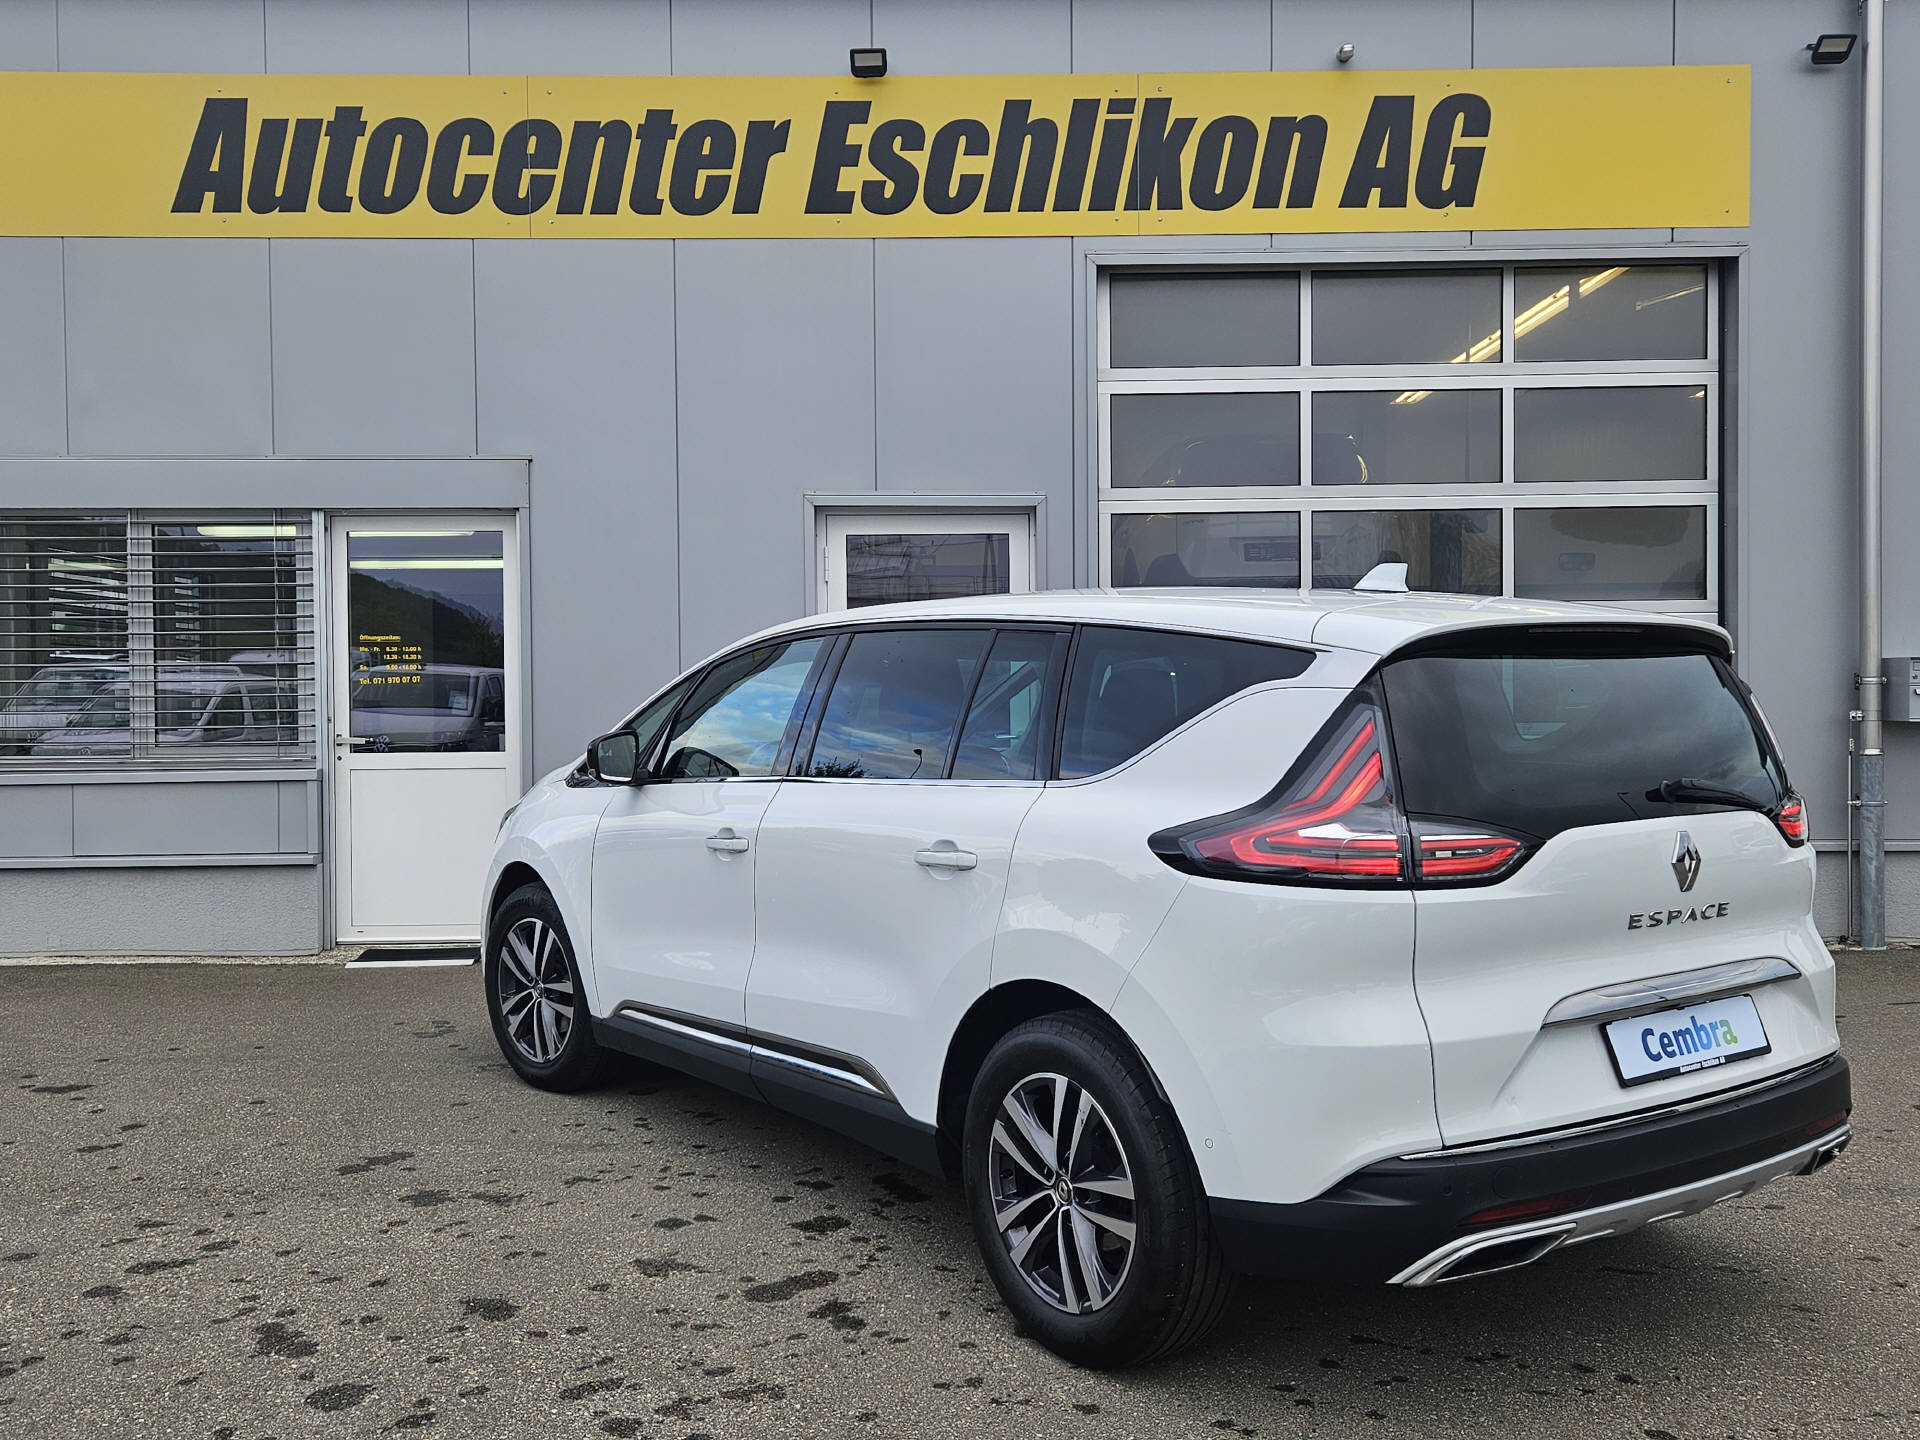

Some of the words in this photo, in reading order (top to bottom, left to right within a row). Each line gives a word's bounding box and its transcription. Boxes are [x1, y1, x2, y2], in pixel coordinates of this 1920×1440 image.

[170, 97, 791, 216] Autocenter
[803, 96, 1328, 215] Eschlikon
[1338, 92, 1492, 209] AG
[1628, 902, 1730, 930] ESPACE
[1641, 1015, 1738, 1062] Cembra
